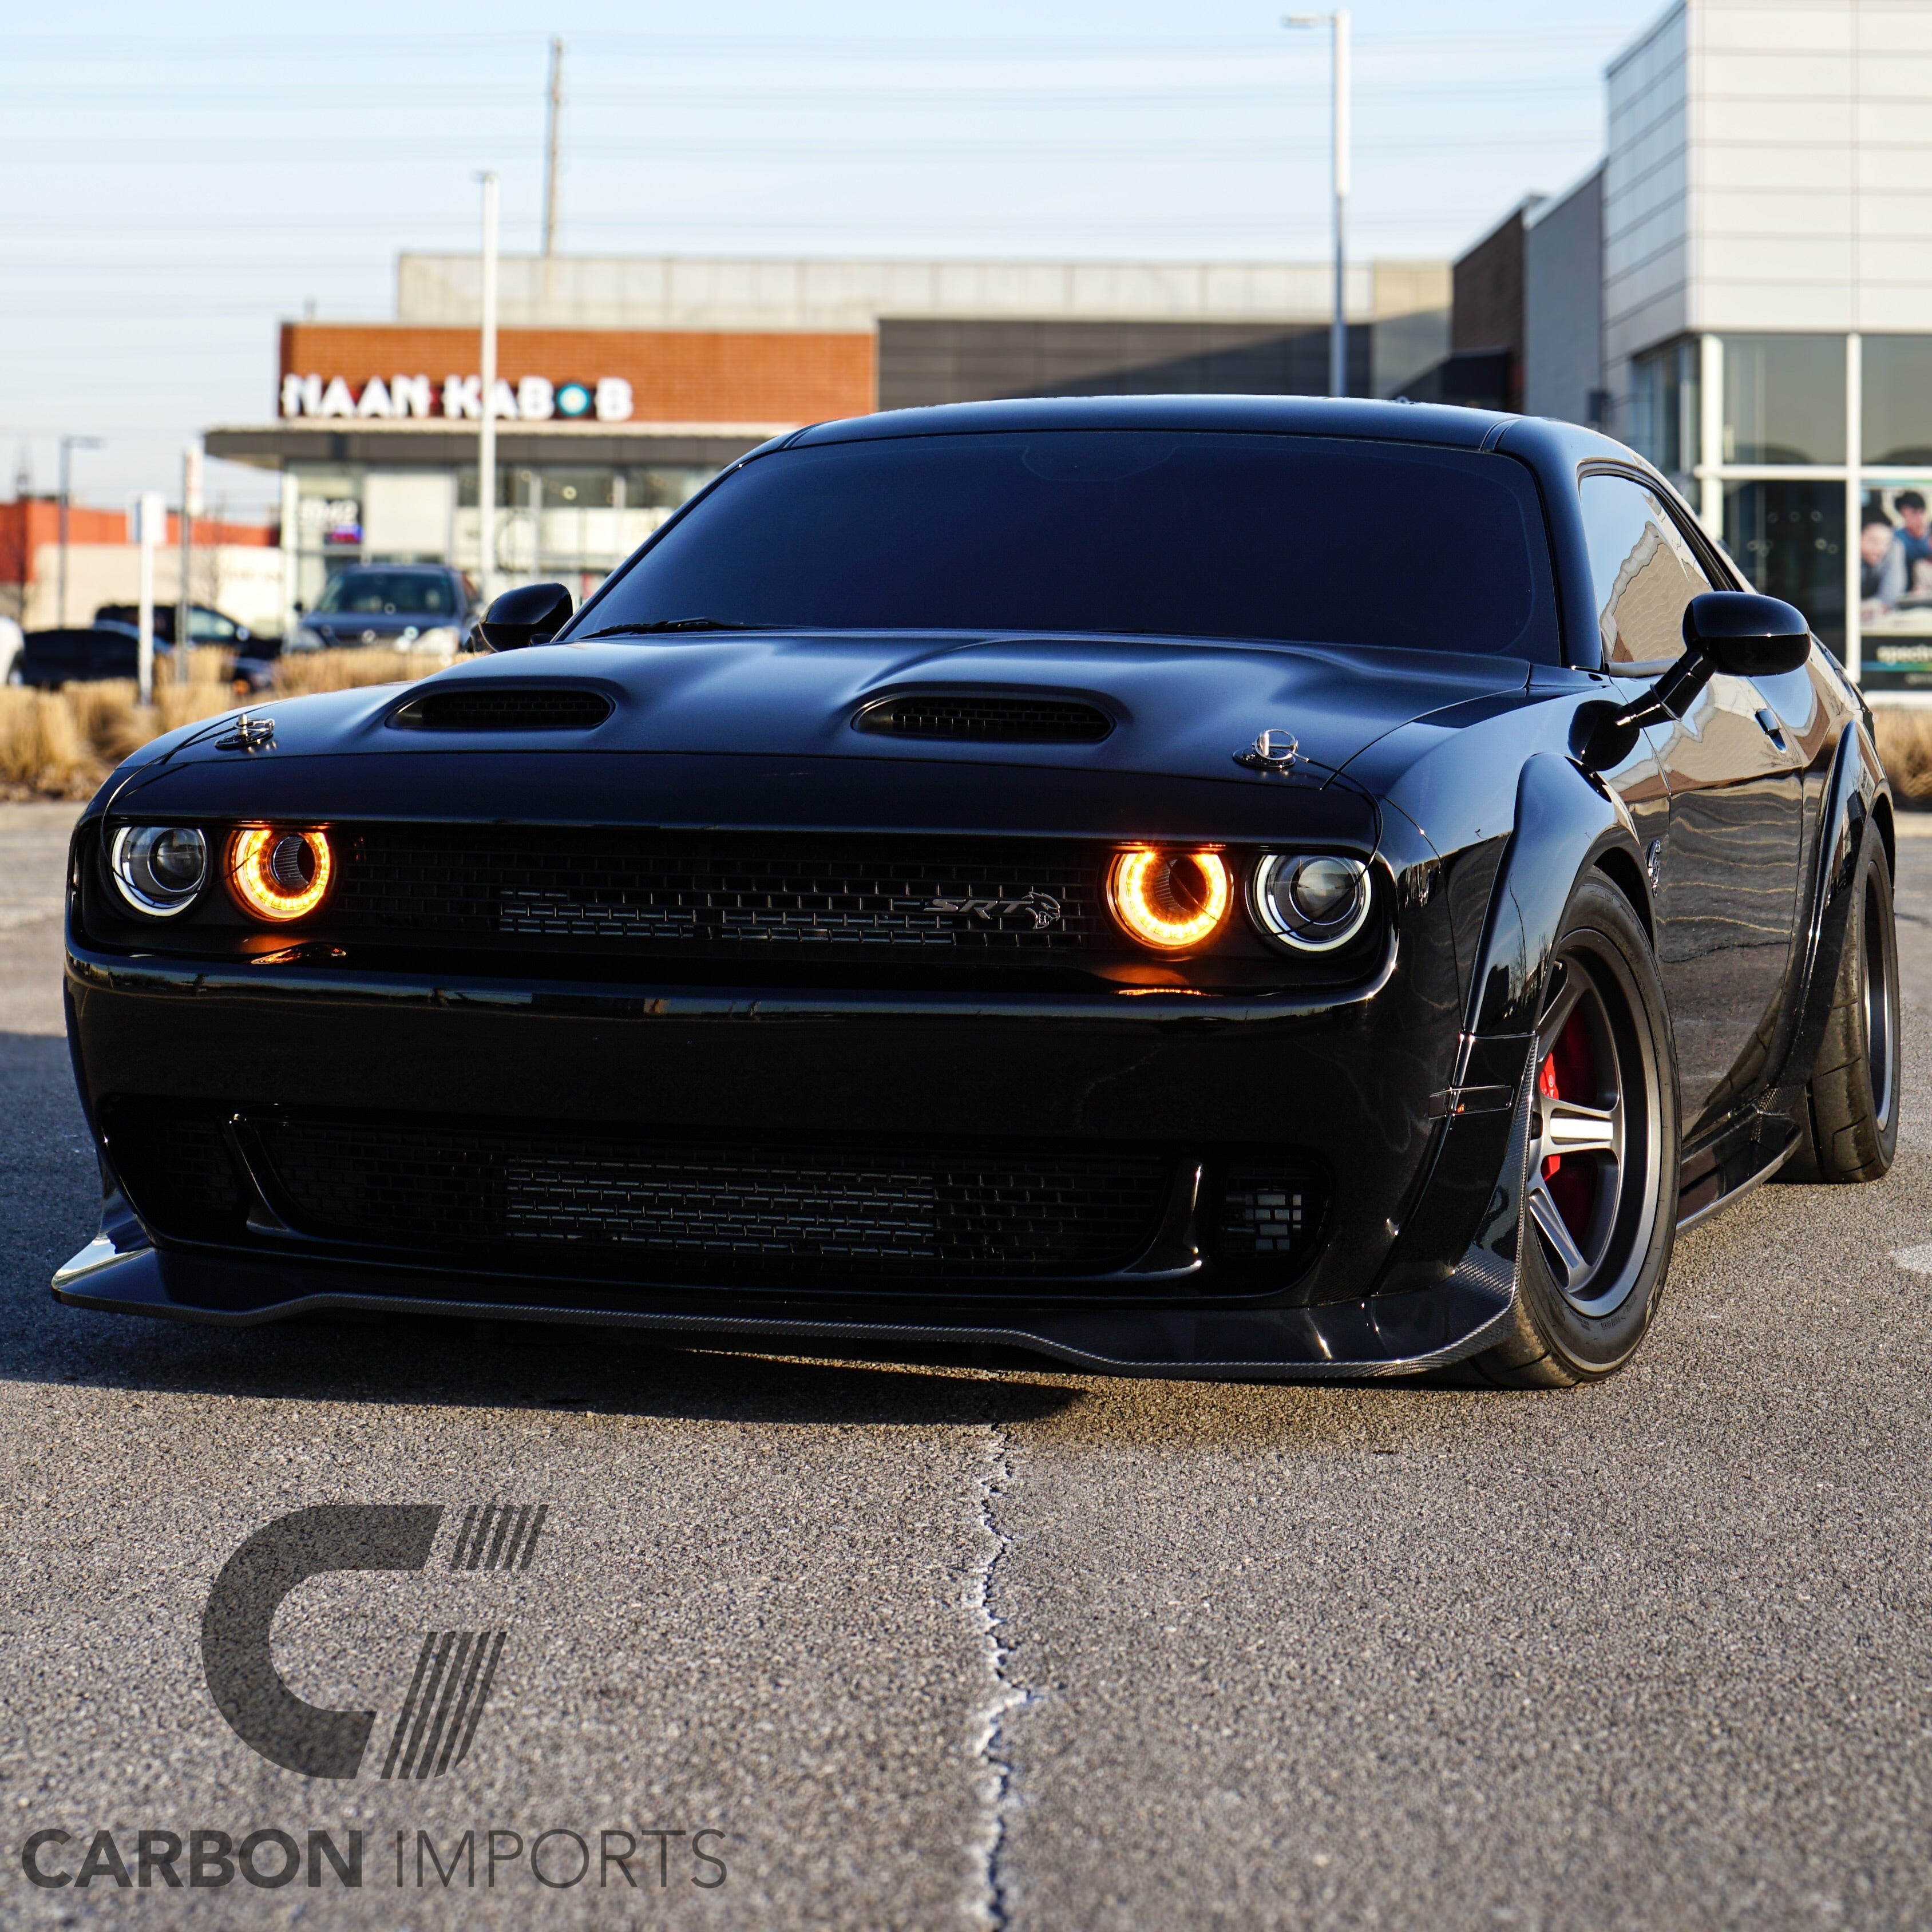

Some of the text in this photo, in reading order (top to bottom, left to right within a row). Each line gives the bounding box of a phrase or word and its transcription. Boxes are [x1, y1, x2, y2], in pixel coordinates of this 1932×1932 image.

[282, 374, 634, 420] NAAN KABOB
[1876, 645, 1932, 666] spectr
[923, 898, 1034, 920] SRT
